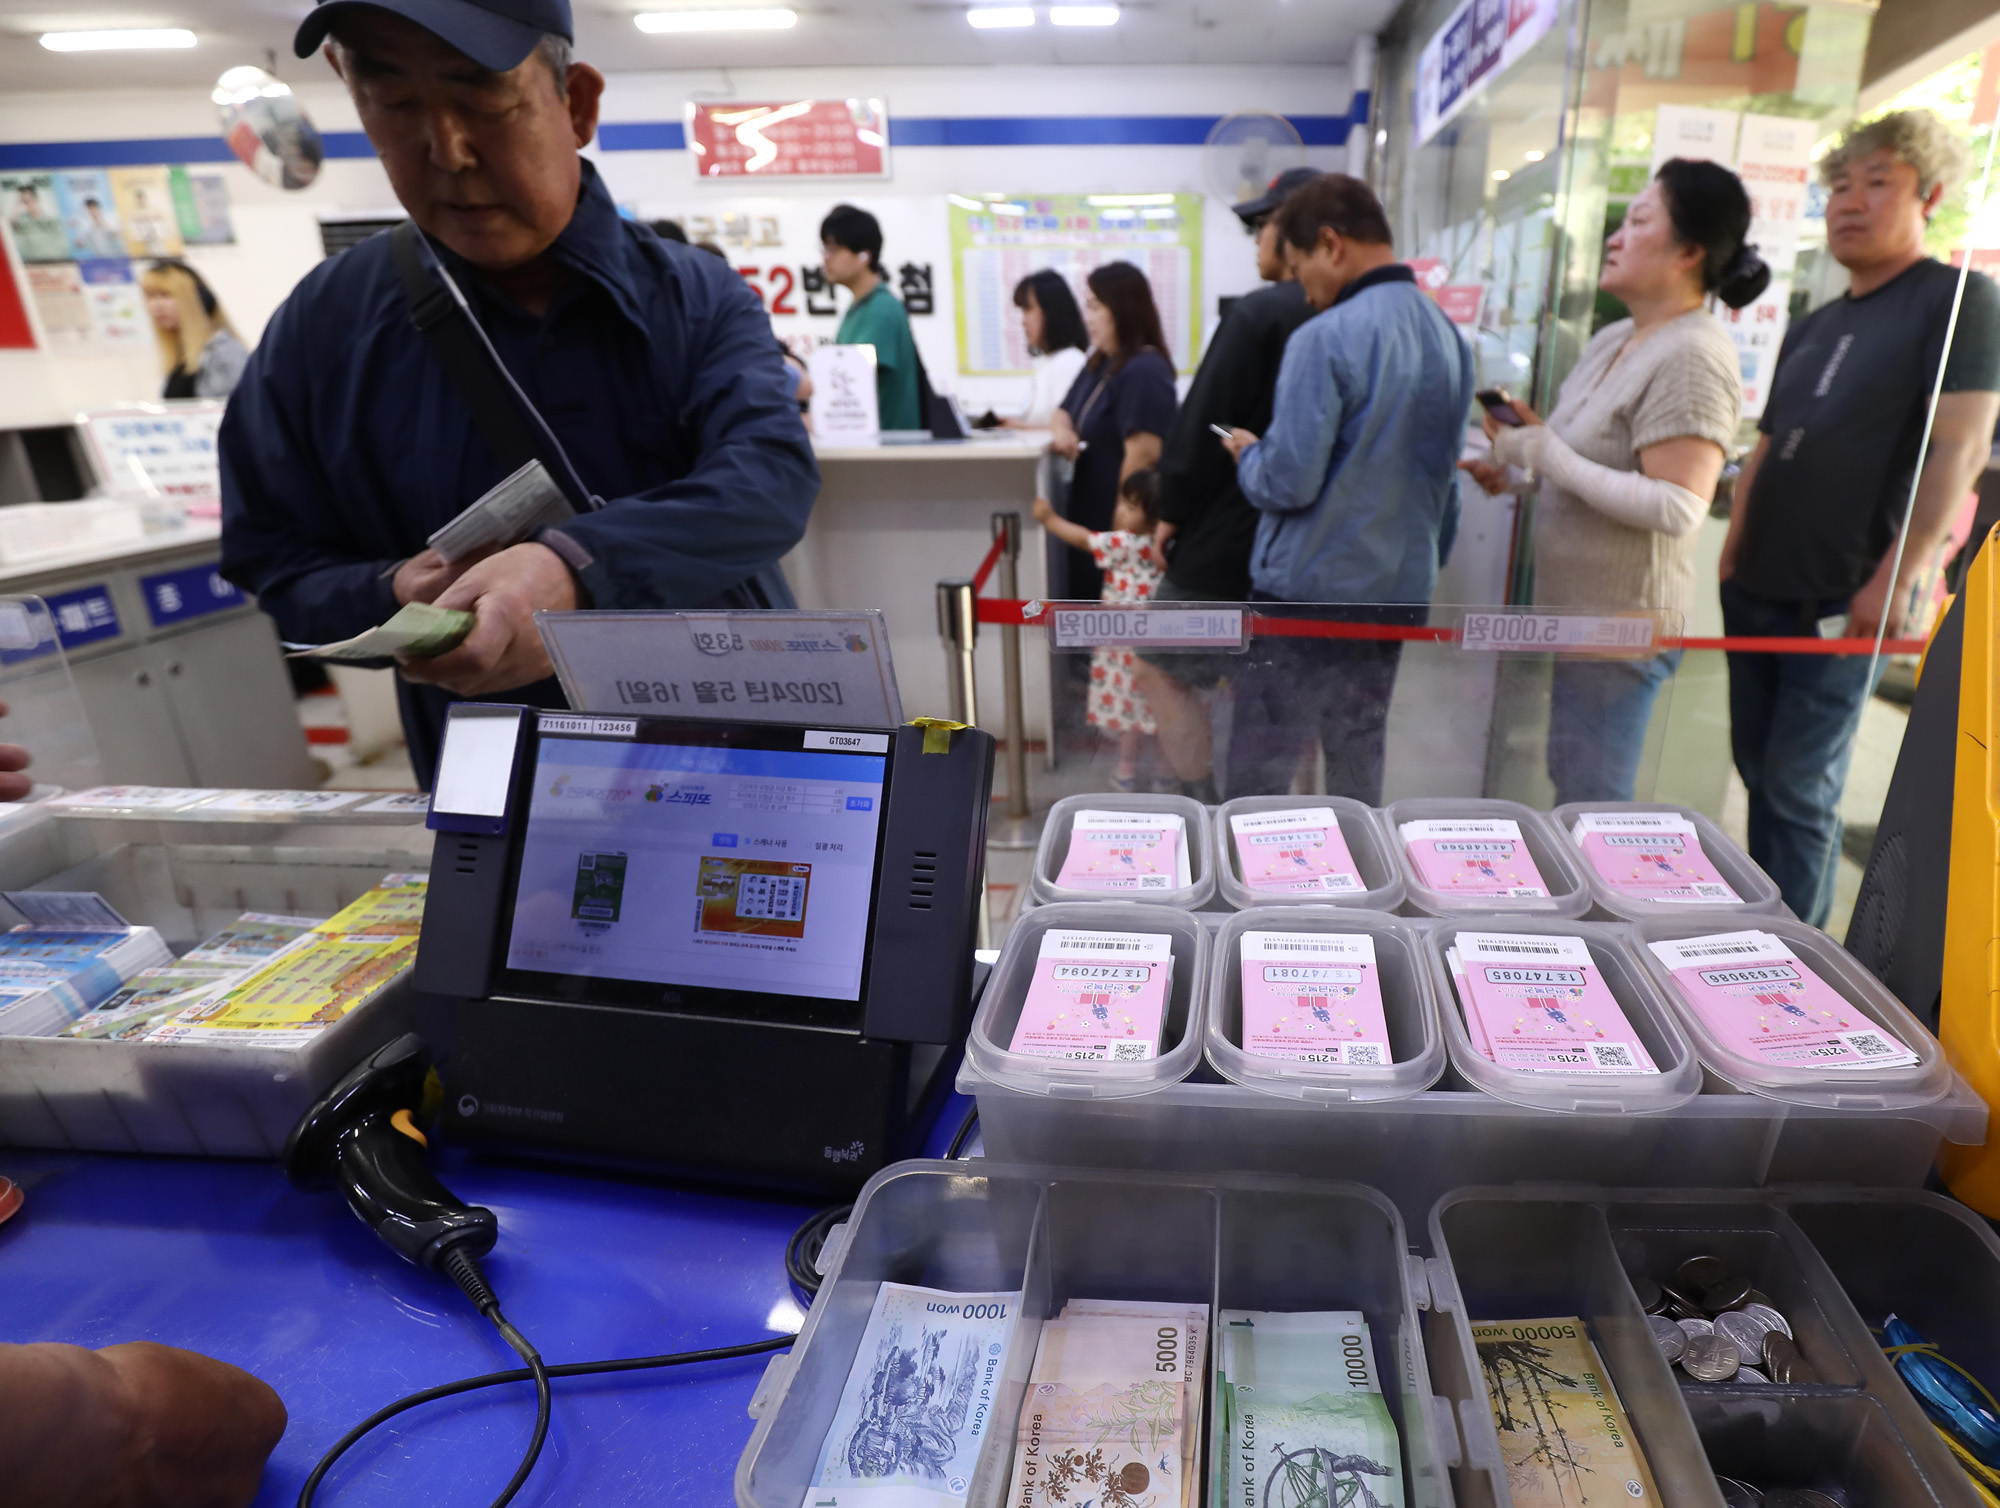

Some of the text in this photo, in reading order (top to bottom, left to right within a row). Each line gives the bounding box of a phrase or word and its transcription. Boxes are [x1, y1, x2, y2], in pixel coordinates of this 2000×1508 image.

[542, 720, 588, 731] 71161011
[597, 722, 632, 733] 123456
[829, 735, 861, 748] GT03647
[665, 791, 712, 806] 스피또
[753, 838, 788, 848] 스캐너 사용
[815, 842, 843, 852] 일괄 처리
[1061, 967, 1141, 978] 1조 747094
[1272, 969, 1329, 978] 747081
[1492, 971, 1576, 982] 1조 747085
[1709, 969, 1789, 983] 1조 639086
[1818, 1047, 1841, 1055] 215
[824, 1146, 858, 1163] 동행복권
[926, 1302, 1007, 1319] 1000 won
[1473, 1325, 1576, 1341] 50000 won
[1155, 1326, 1178, 1373] 5000
[1185, 1335, 1198, 1369] 7964035
[1341, 1335, 1370, 1388] 10000
[983, 1358, 998, 1386] Bank
[1184, 1370, 1193, 1383] BC
[980, 1388, 992, 1400] of
[1583, 1372, 1624, 1448] Bank of Korea
[971, 1403, 988, 1436] Korea
[1026, 1414, 1042, 1457] Korea
[1026, 1459, 1037, 1476] of
[1242, 1414, 1255, 1508] ank of Korea
